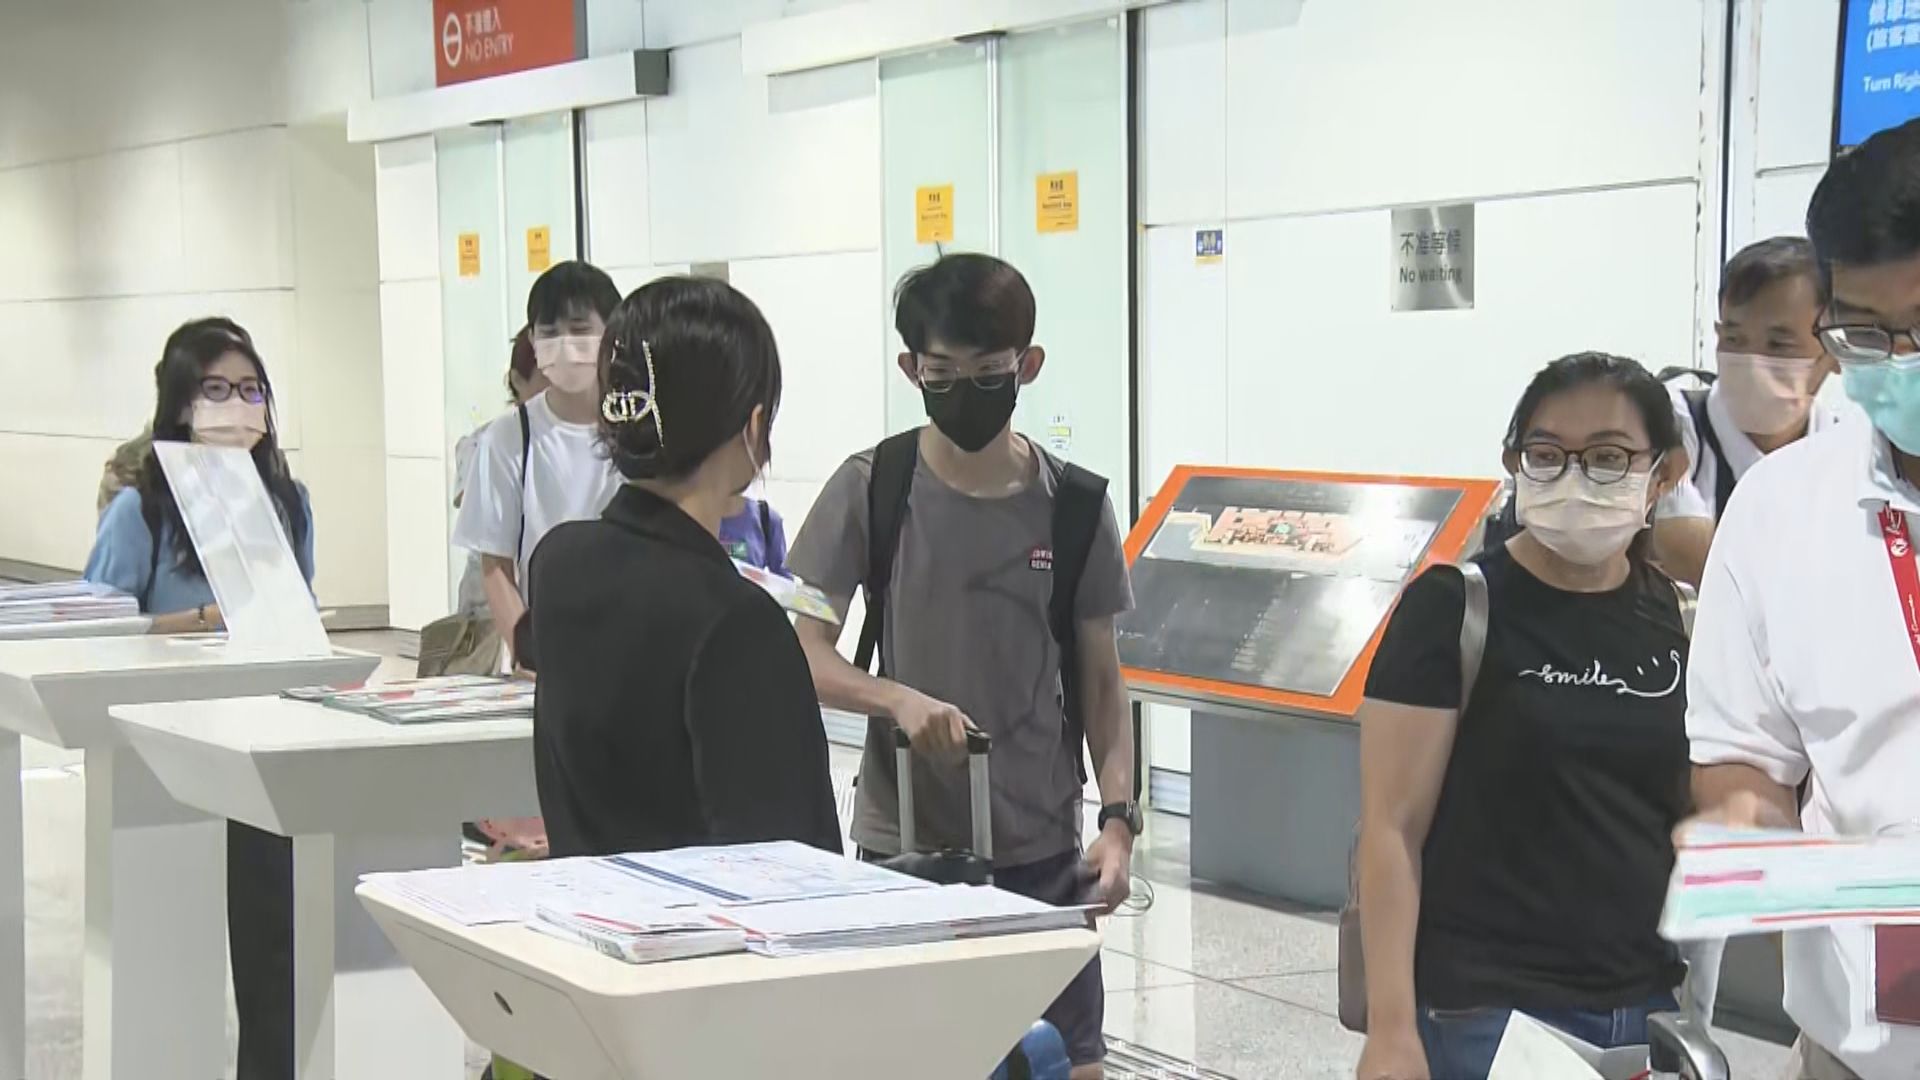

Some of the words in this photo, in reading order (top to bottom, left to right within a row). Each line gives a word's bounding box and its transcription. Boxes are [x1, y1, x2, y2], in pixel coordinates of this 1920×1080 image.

[464, 38, 482, 63] NO
[483, 32, 514, 61] ENTRY
[1863, 74, 1891, 93] Turn
[1399, 266, 1416, 283] No
[1418, 263, 1463, 285] waiting
